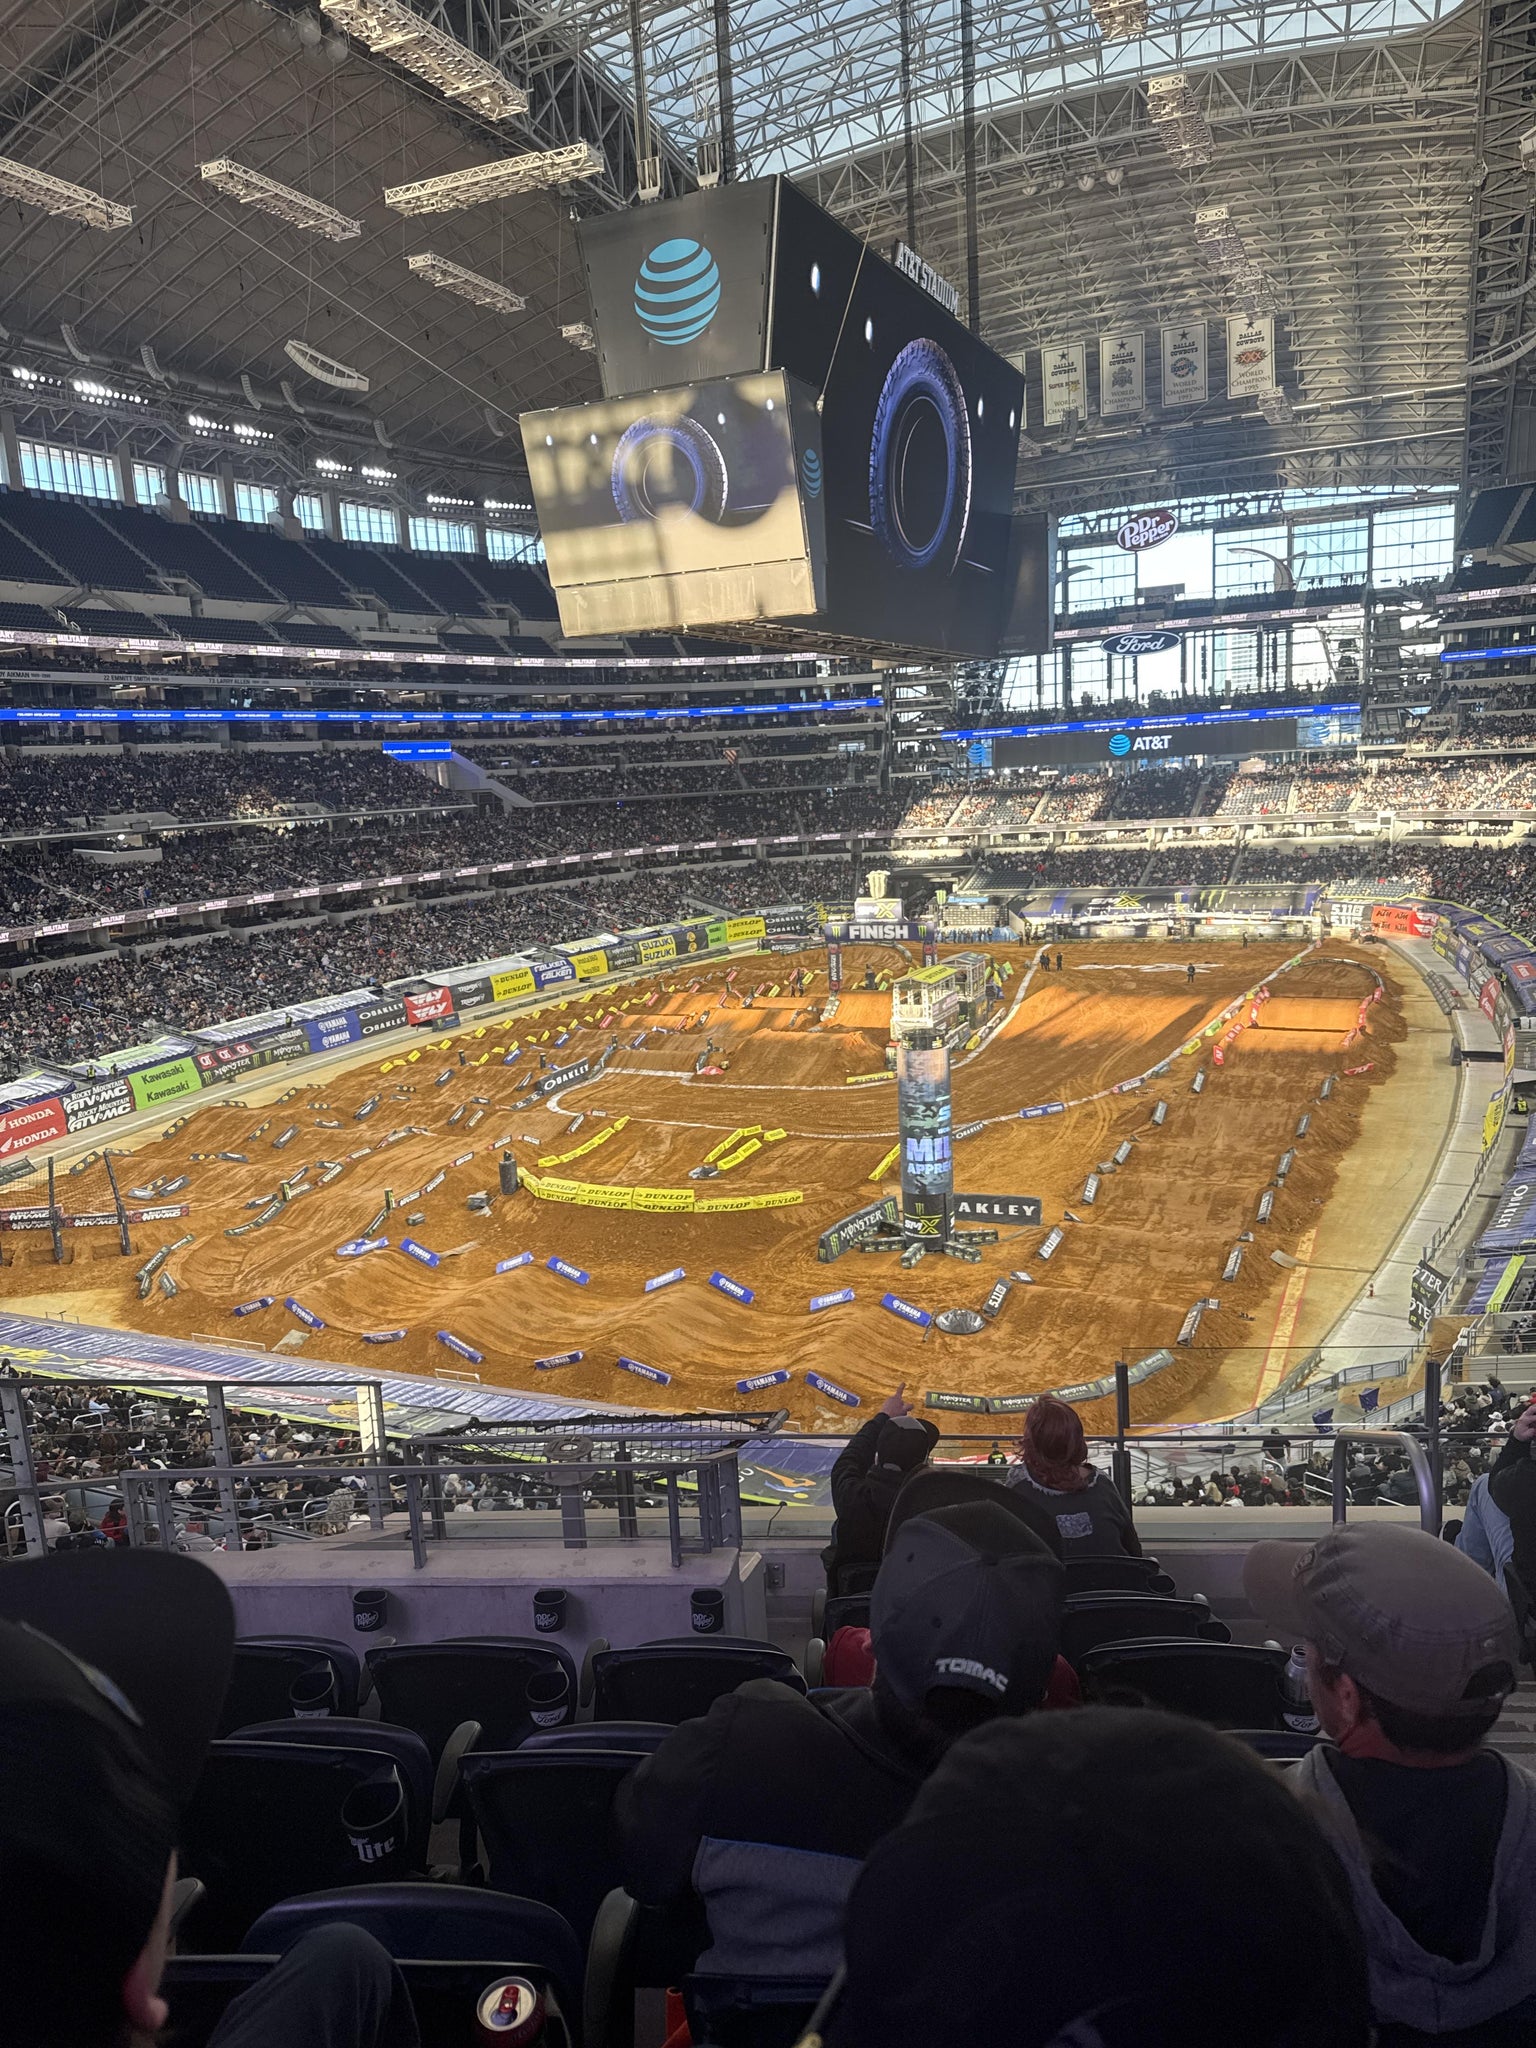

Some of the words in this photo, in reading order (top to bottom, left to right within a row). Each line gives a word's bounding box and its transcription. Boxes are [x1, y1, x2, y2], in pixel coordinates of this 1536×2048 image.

[895, 242, 921, 283] AT&T
[921, 262, 959, 315] STADIUM
[1239, 331, 1262, 339] DALLAS
[1173, 341, 1195, 350] DALLAS
[1236, 336, 1264, 346] COWBOYS
[1170, 347, 1198, 356] COWBOYS
[1053, 362, 1074, 370] DALLAS
[1109, 357, 1136, 366] COWBOYS
[1051, 367, 1077, 376] COWBOYS
[1239, 370, 1263, 378] WORLD
[1173, 380, 1197, 388] WORLD
[1231, 376, 1271, 387] CHAMPIONS
[1111, 389, 1134, 397] WORLD
[1166, 386, 1203, 396] CHAMPIONS
[1054, 399, 1076, 407] WORLD
[1105, 396, 1141, 405] CHAMPIONS
[1137, 516, 1160, 535] Dr
[1123, 519, 1175, 549] Pepper
[1469, 588, 1501, 598] MILITARY
[1221, 613, 1248, 622] MILITARY
[1280, 608, 1307, 616] MILITARY
[1108, 624, 1133, 632] MILITARY
[1164, 619, 1190, 627] MILITARY
[57, 635, 89, 643] MILITARY
[129, 639, 159, 647] MILITARY
[1116, 635, 1165, 652] Ford
[1133, 735, 1171, 751] AT&T
[205, 900, 228, 909] MILITARY
[154, 907, 177, 916] MILITARY
[101, 915, 125, 924] MILITARY
[733, 919, 760, 928] DUNLOP
[776, 915, 804, 923] OAKLEY
[43, 923, 69, 932] MILITARY
[849, 925, 909, 939] FINISH
[734, 929, 762, 938] DUNLOP
[641, 937, 673, 951] SUZUKI
[644, 949, 675, 962] SUZUKI
[534, 960, 567, 973] FALKEN
[500, 971, 529, 983] DUNLOP
[541, 968, 572, 981] FALKEN
[503, 983, 532, 996] DUNLOP
[371, 1003, 404, 1017] OAKLEY
[324, 1017, 348, 1029] YAMAHA
[373, 1016, 407, 1030] OAKLEY
[328, 1031, 350, 1044] YAMAHA
[274, 1044, 303, 1056] MONSTER
[214, 1058, 250, 1075] MONSTER
[141, 1064, 185, 1085] Kawasaki
[557, 1063, 589, 1085] OAKLEY
[71, 1089, 91, 1101] ROCKY
[92, 1080, 125, 1095] MOUNTAIN
[147, 1080, 190, 1102] Kawasaki
[77, 1107, 97, 1118] ROCKY
[98, 1097, 130, 1112] MOUNTAIN
[8, 1108, 55, 1129] HONDA
[13, 1127, 59, 1149] HONDA
[545, 1182, 577, 1193] DUNLOP
[587, 1188, 630, 1198] DUNLOP
[548, 1192, 576, 1203] DUNLOP
[645, 1191, 692, 1200] DUNLOP
[764, 1195, 801, 1207] DUNLOP
[587, 1198, 628, 1209] DUNLOP
[645, 1204, 689, 1212] DUNLOP
[706, 1201, 750, 1211] DUNLOP
[839, 1210, 883, 1240] MONSTER
[904, 1217, 942, 1235] SMX
[413, 1245, 433, 1260] YAMAHA
[561, 1264, 581, 1279] YAMAHA
[724, 1281, 745, 1296] YAMAHA
[244, 1301, 261, 1312] YAMAHA
[899, 1303, 921, 1318] YAMAHA
[295, 1307, 314, 1324] YAMAHA
[551, 1356, 570, 1366] YAMAHA
[633, 1366, 657, 1381] YAMAHA
[753, 1374, 776, 1388] YAMAHA
[823, 1385, 847, 1402] YAMAHA
[1059, 1385, 1088, 1396] MONSTER
[940, 1395, 971, 1404] MONSTER
[1002, 1397, 1034, 1406] MONSTER
[935, 1657, 1009, 1692] TOMAC
[536, 1712, 561, 1724] Ford
[351, 1836, 394, 1863] Lite
